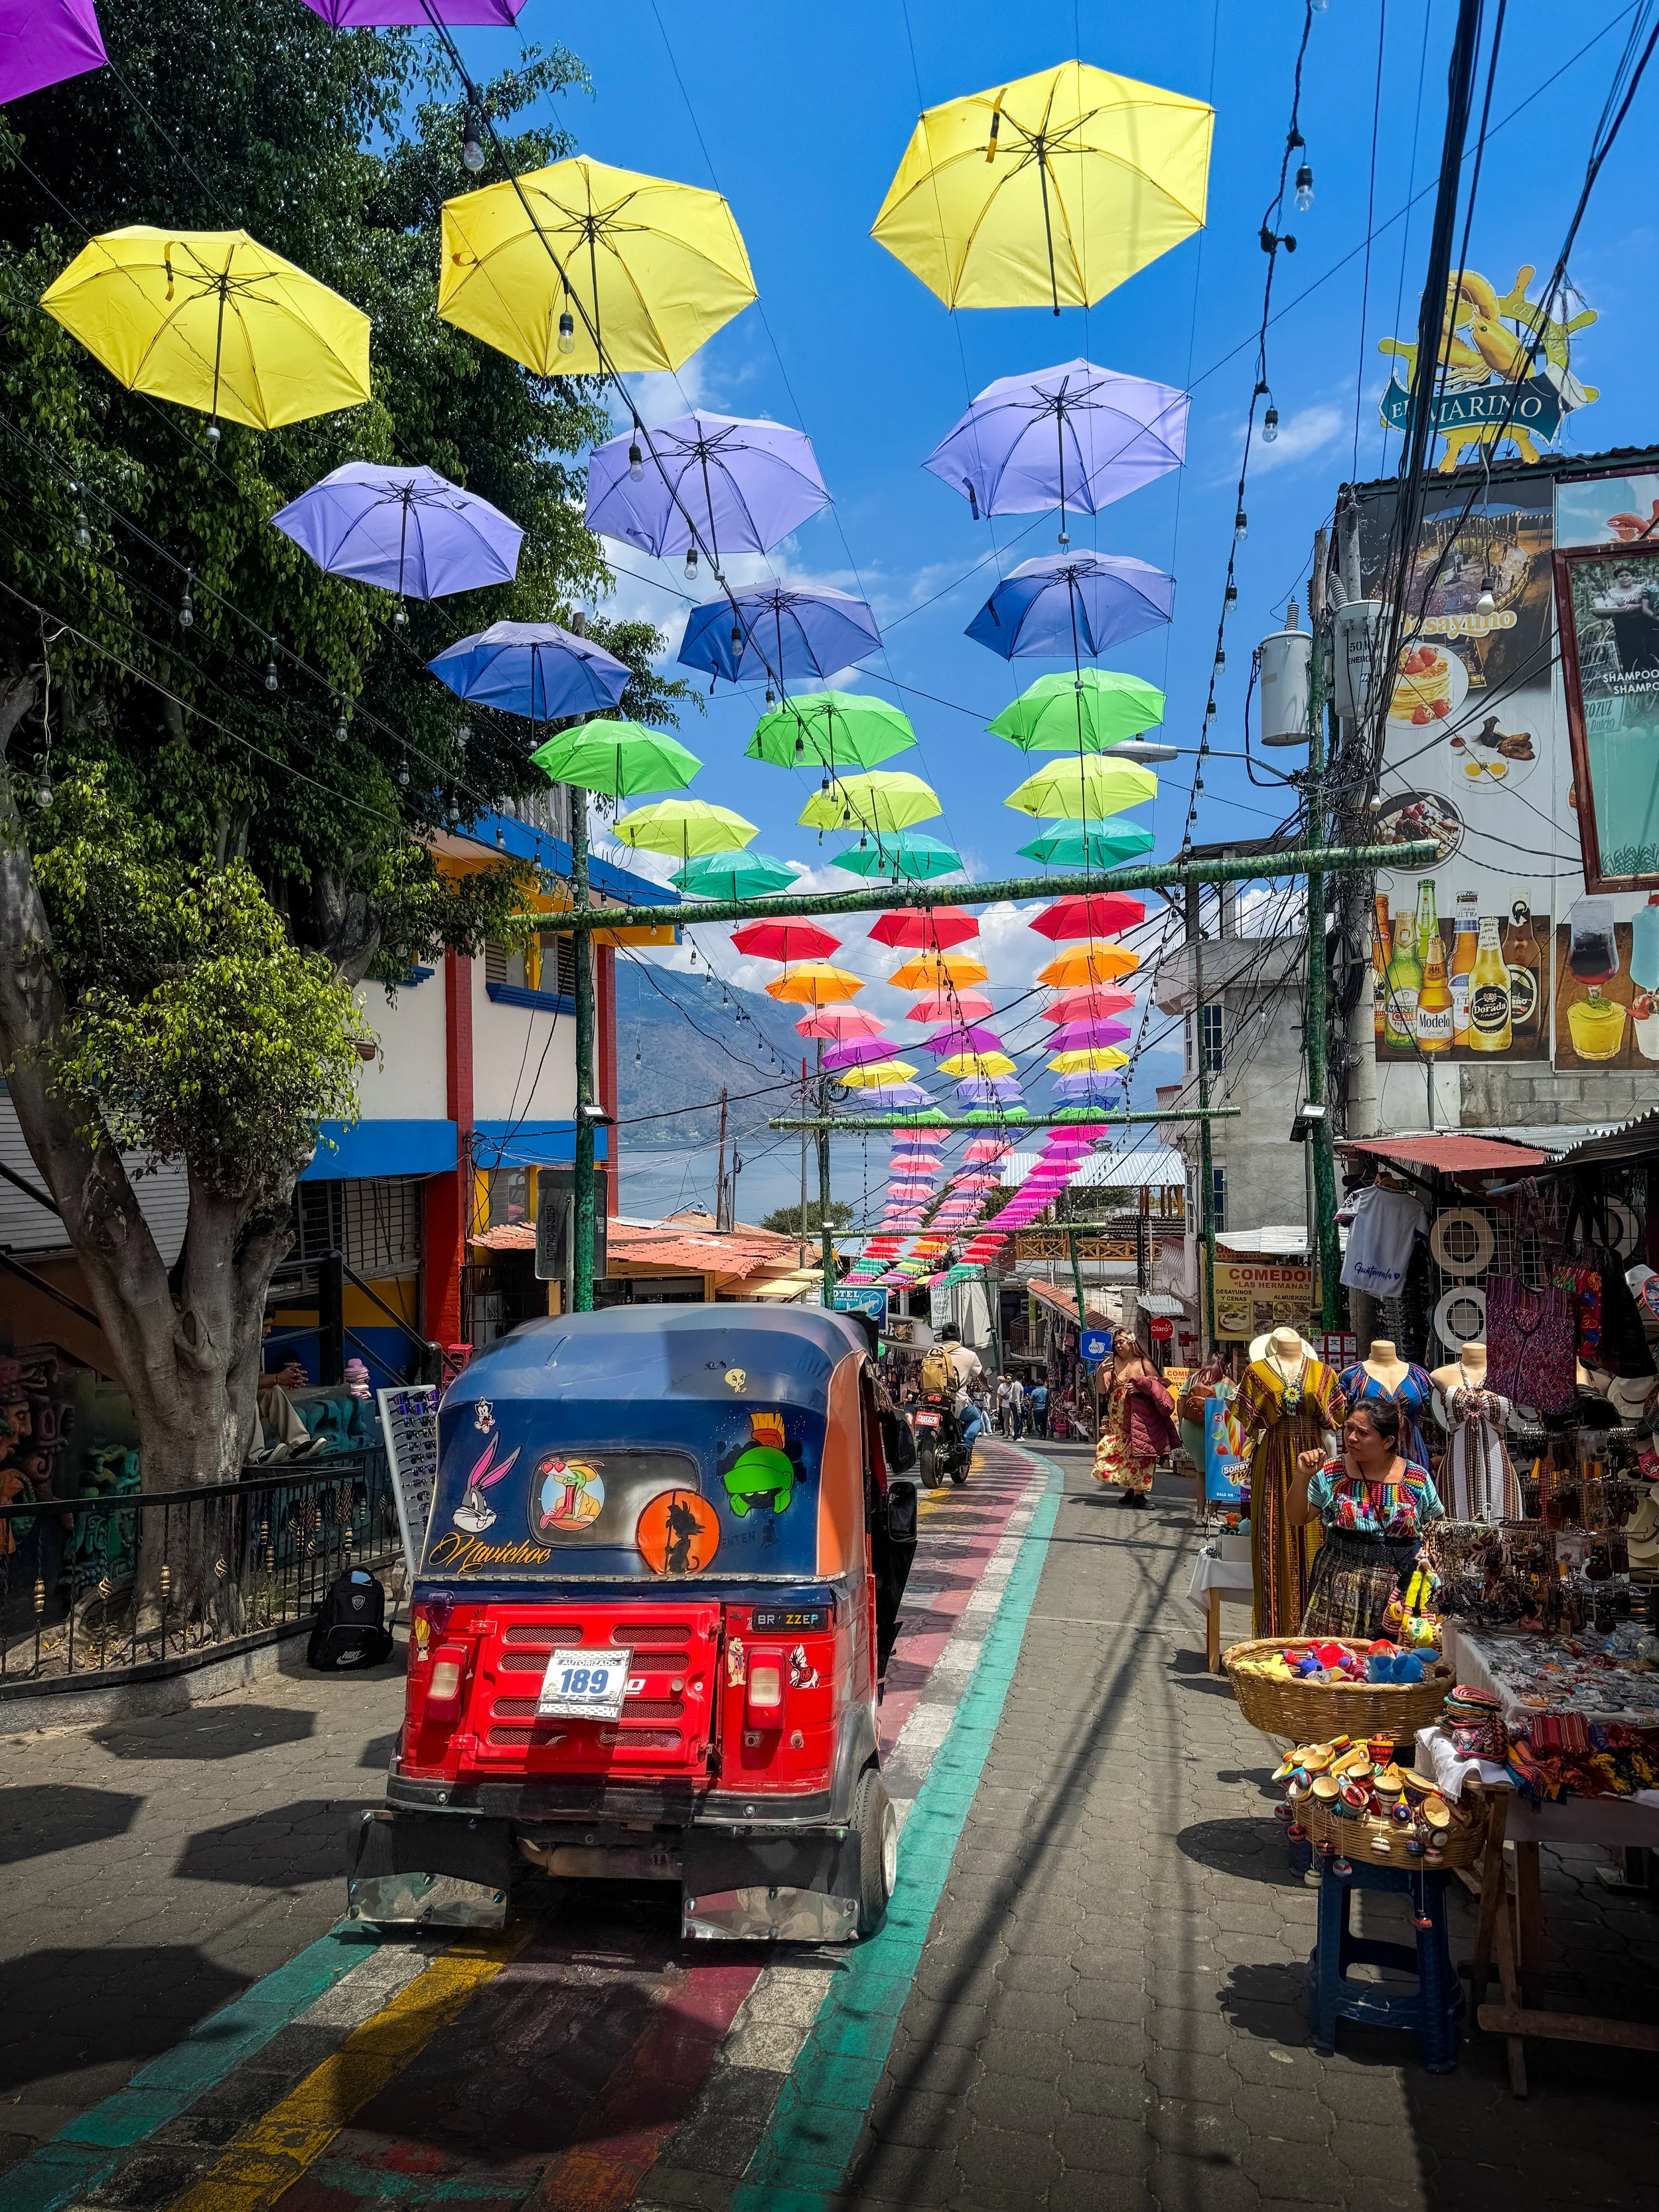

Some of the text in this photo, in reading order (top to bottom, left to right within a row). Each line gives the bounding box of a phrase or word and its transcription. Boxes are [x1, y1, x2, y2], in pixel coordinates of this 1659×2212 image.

[1429, 396, 1542, 423] MARINO
[1350, 641, 1362, 652] 50
[1603, 669, 1659, 683] SHAMPOO
[1474, 1001, 1506, 1014] Dorada
[1419, 1013, 1450, 1027] Modelo
[1229, 1268, 1319, 1283] COMEDOR
[1354, 1262, 1392, 1280] Guatemala
[833, 1290, 860, 1298] OTEL
[1224, 1463, 1250, 1474] SORBY
[342, 1651, 362, 1659] NIKE
[561, 1668, 609, 1694] 189
